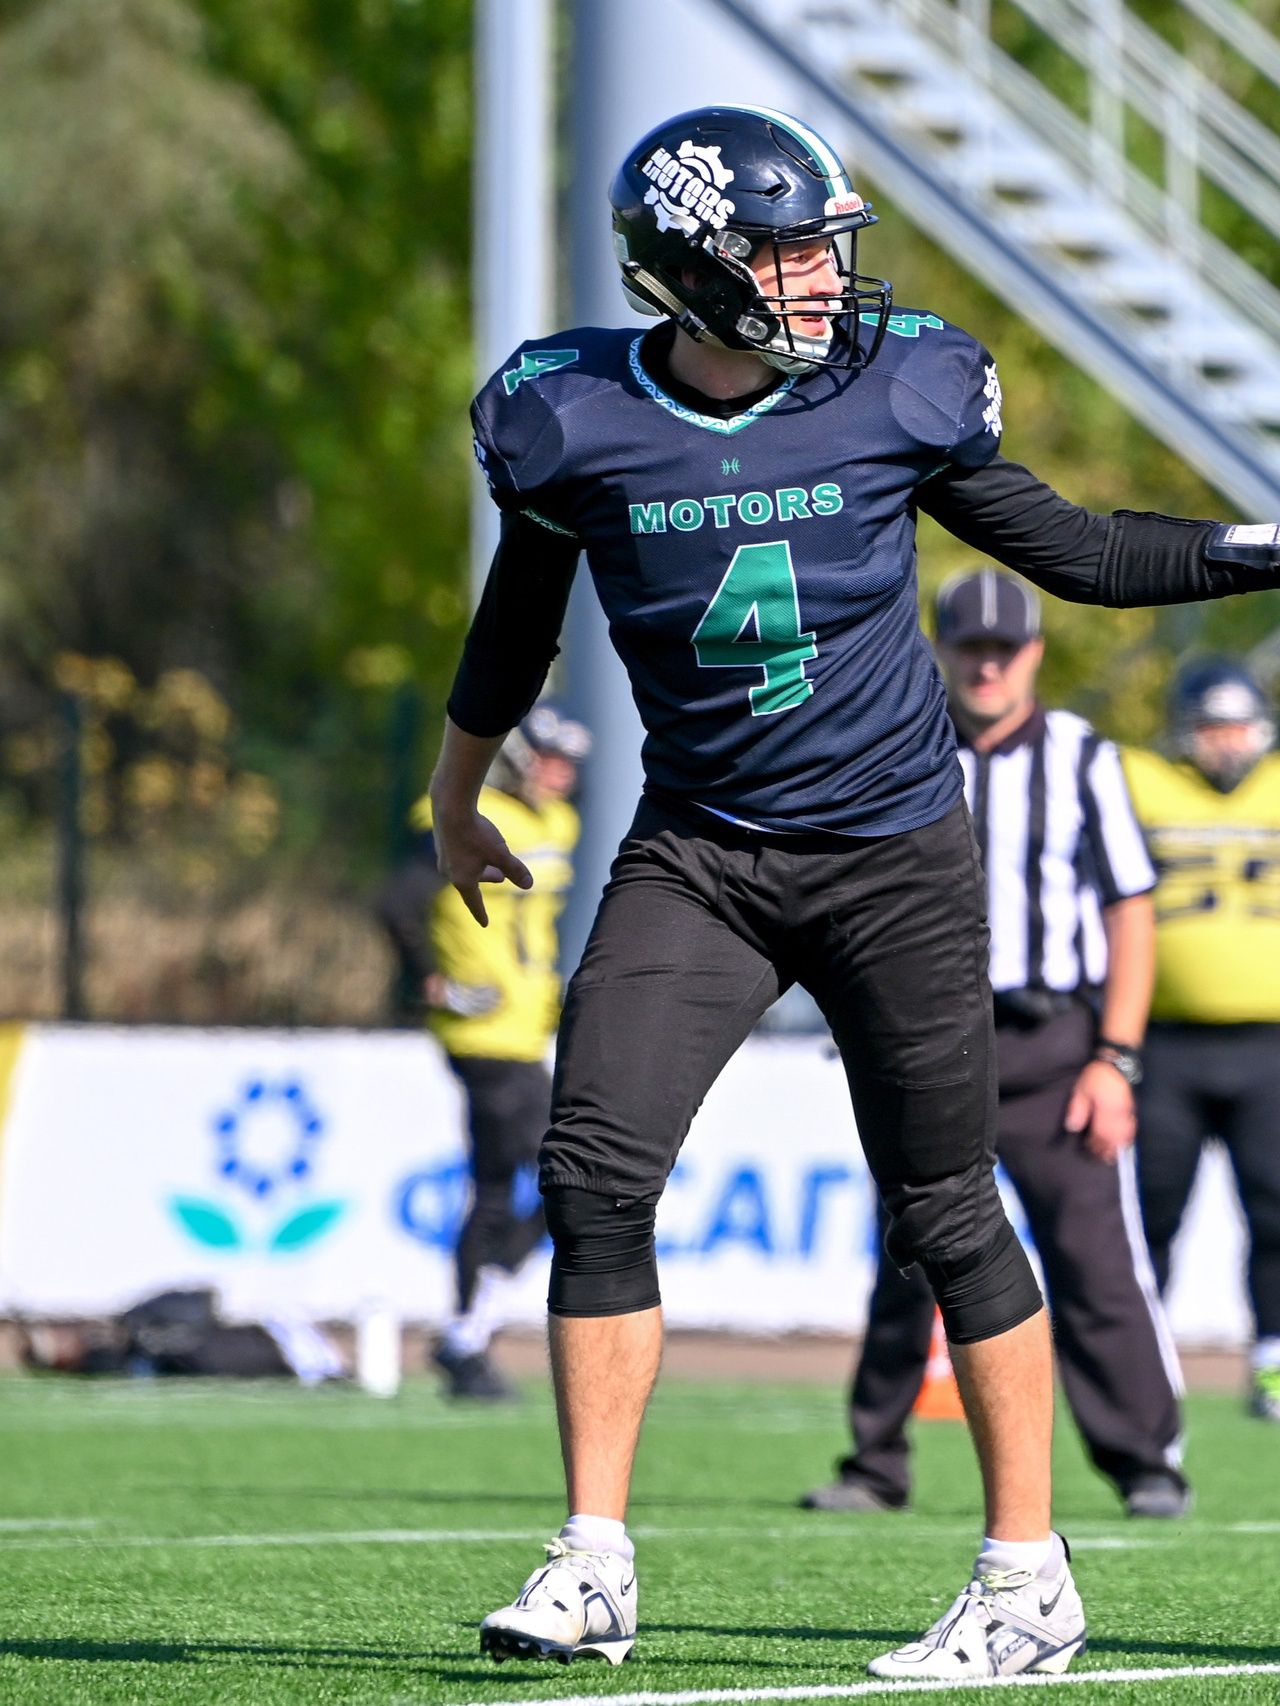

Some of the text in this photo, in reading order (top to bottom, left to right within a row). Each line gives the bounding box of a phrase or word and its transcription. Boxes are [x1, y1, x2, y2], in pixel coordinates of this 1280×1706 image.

[859, 312, 944, 338] 4
[502, 350, 579, 393] 4
[628, 483, 843, 534] MOTORS
[690, 540, 817, 716] 4
